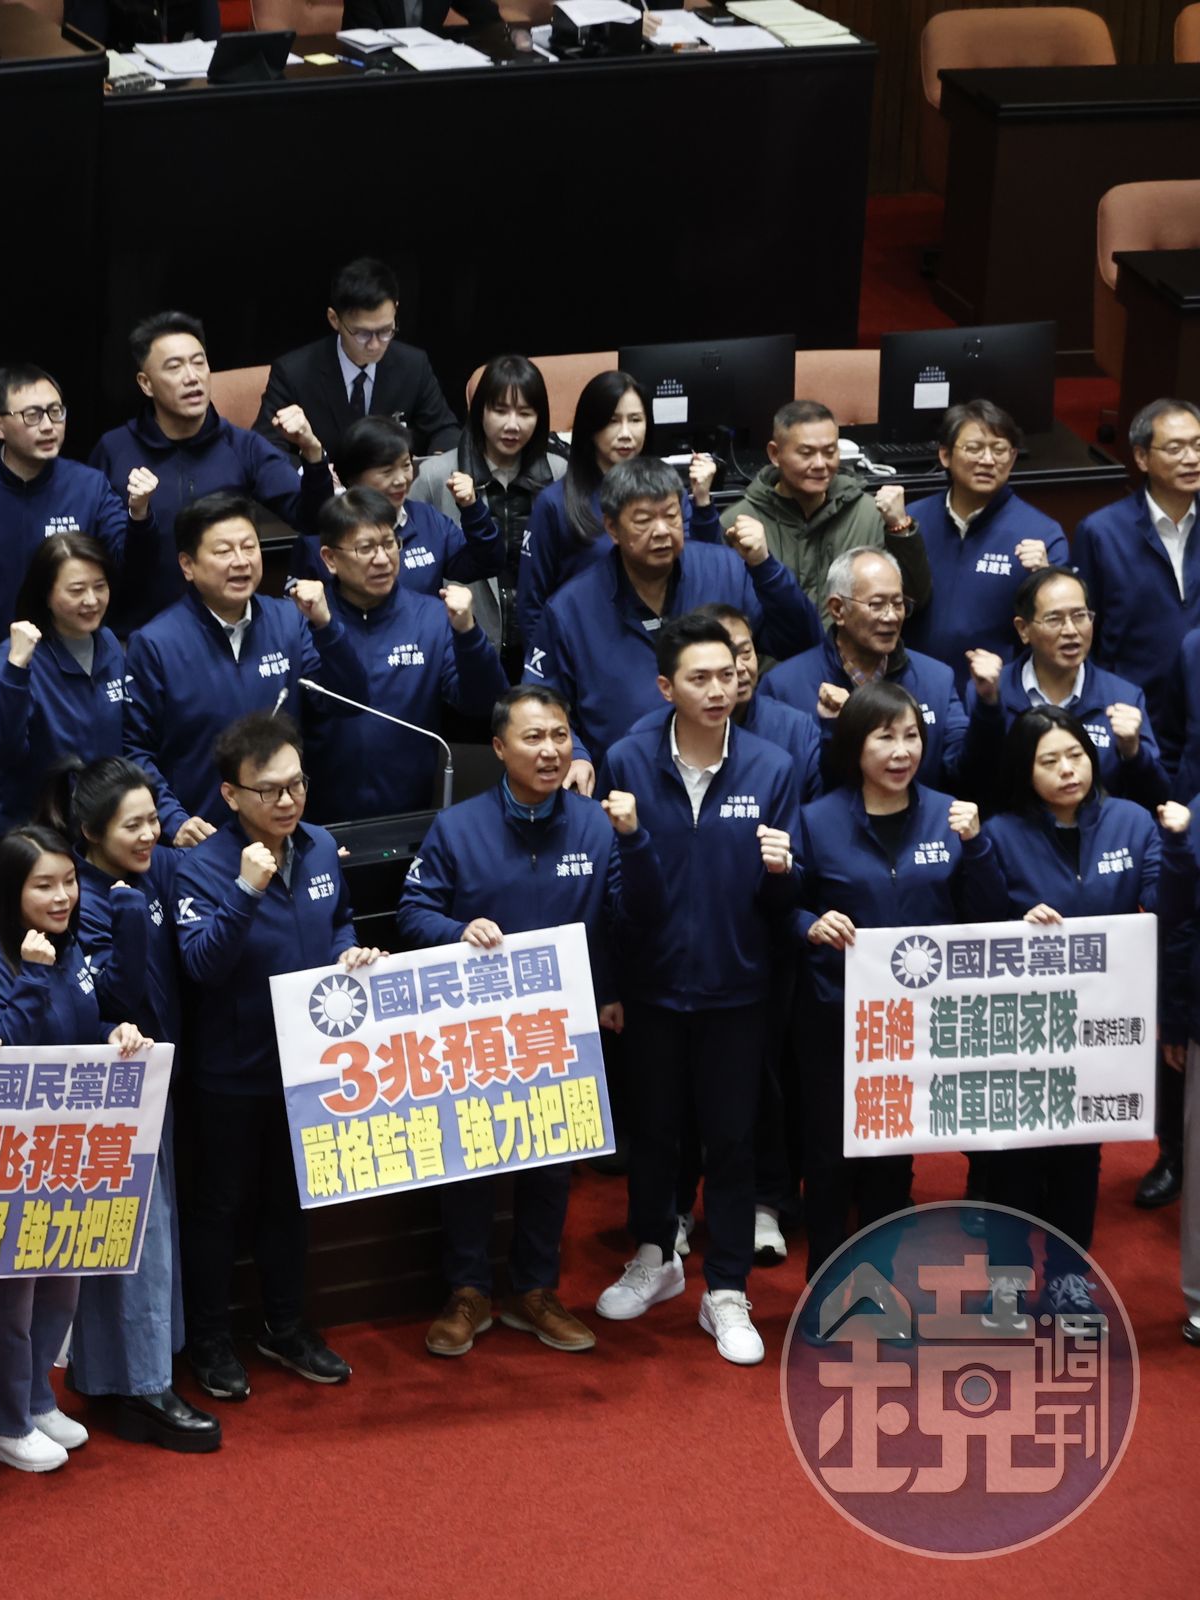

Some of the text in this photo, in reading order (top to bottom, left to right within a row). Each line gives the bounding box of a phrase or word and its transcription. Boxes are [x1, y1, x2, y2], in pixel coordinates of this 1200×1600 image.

[369, 944, 563, 1022] 國民黨團
[947, 932, 1107, 980] 國民黨團
[320, 1008, 575, 1114] 3兆預算
[855, 997, 915, 1063] 拒絕
[929, 989, 1078, 1059] 造謠國家隊
[301, 1076, 605, 1198] 嚴格監督 強力把關
[853, 1074, 915, 1140] 解散
[929, 1066, 1077, 1137] 網軍國家隊
[14, 1197, 140, 1272] 強力把關
